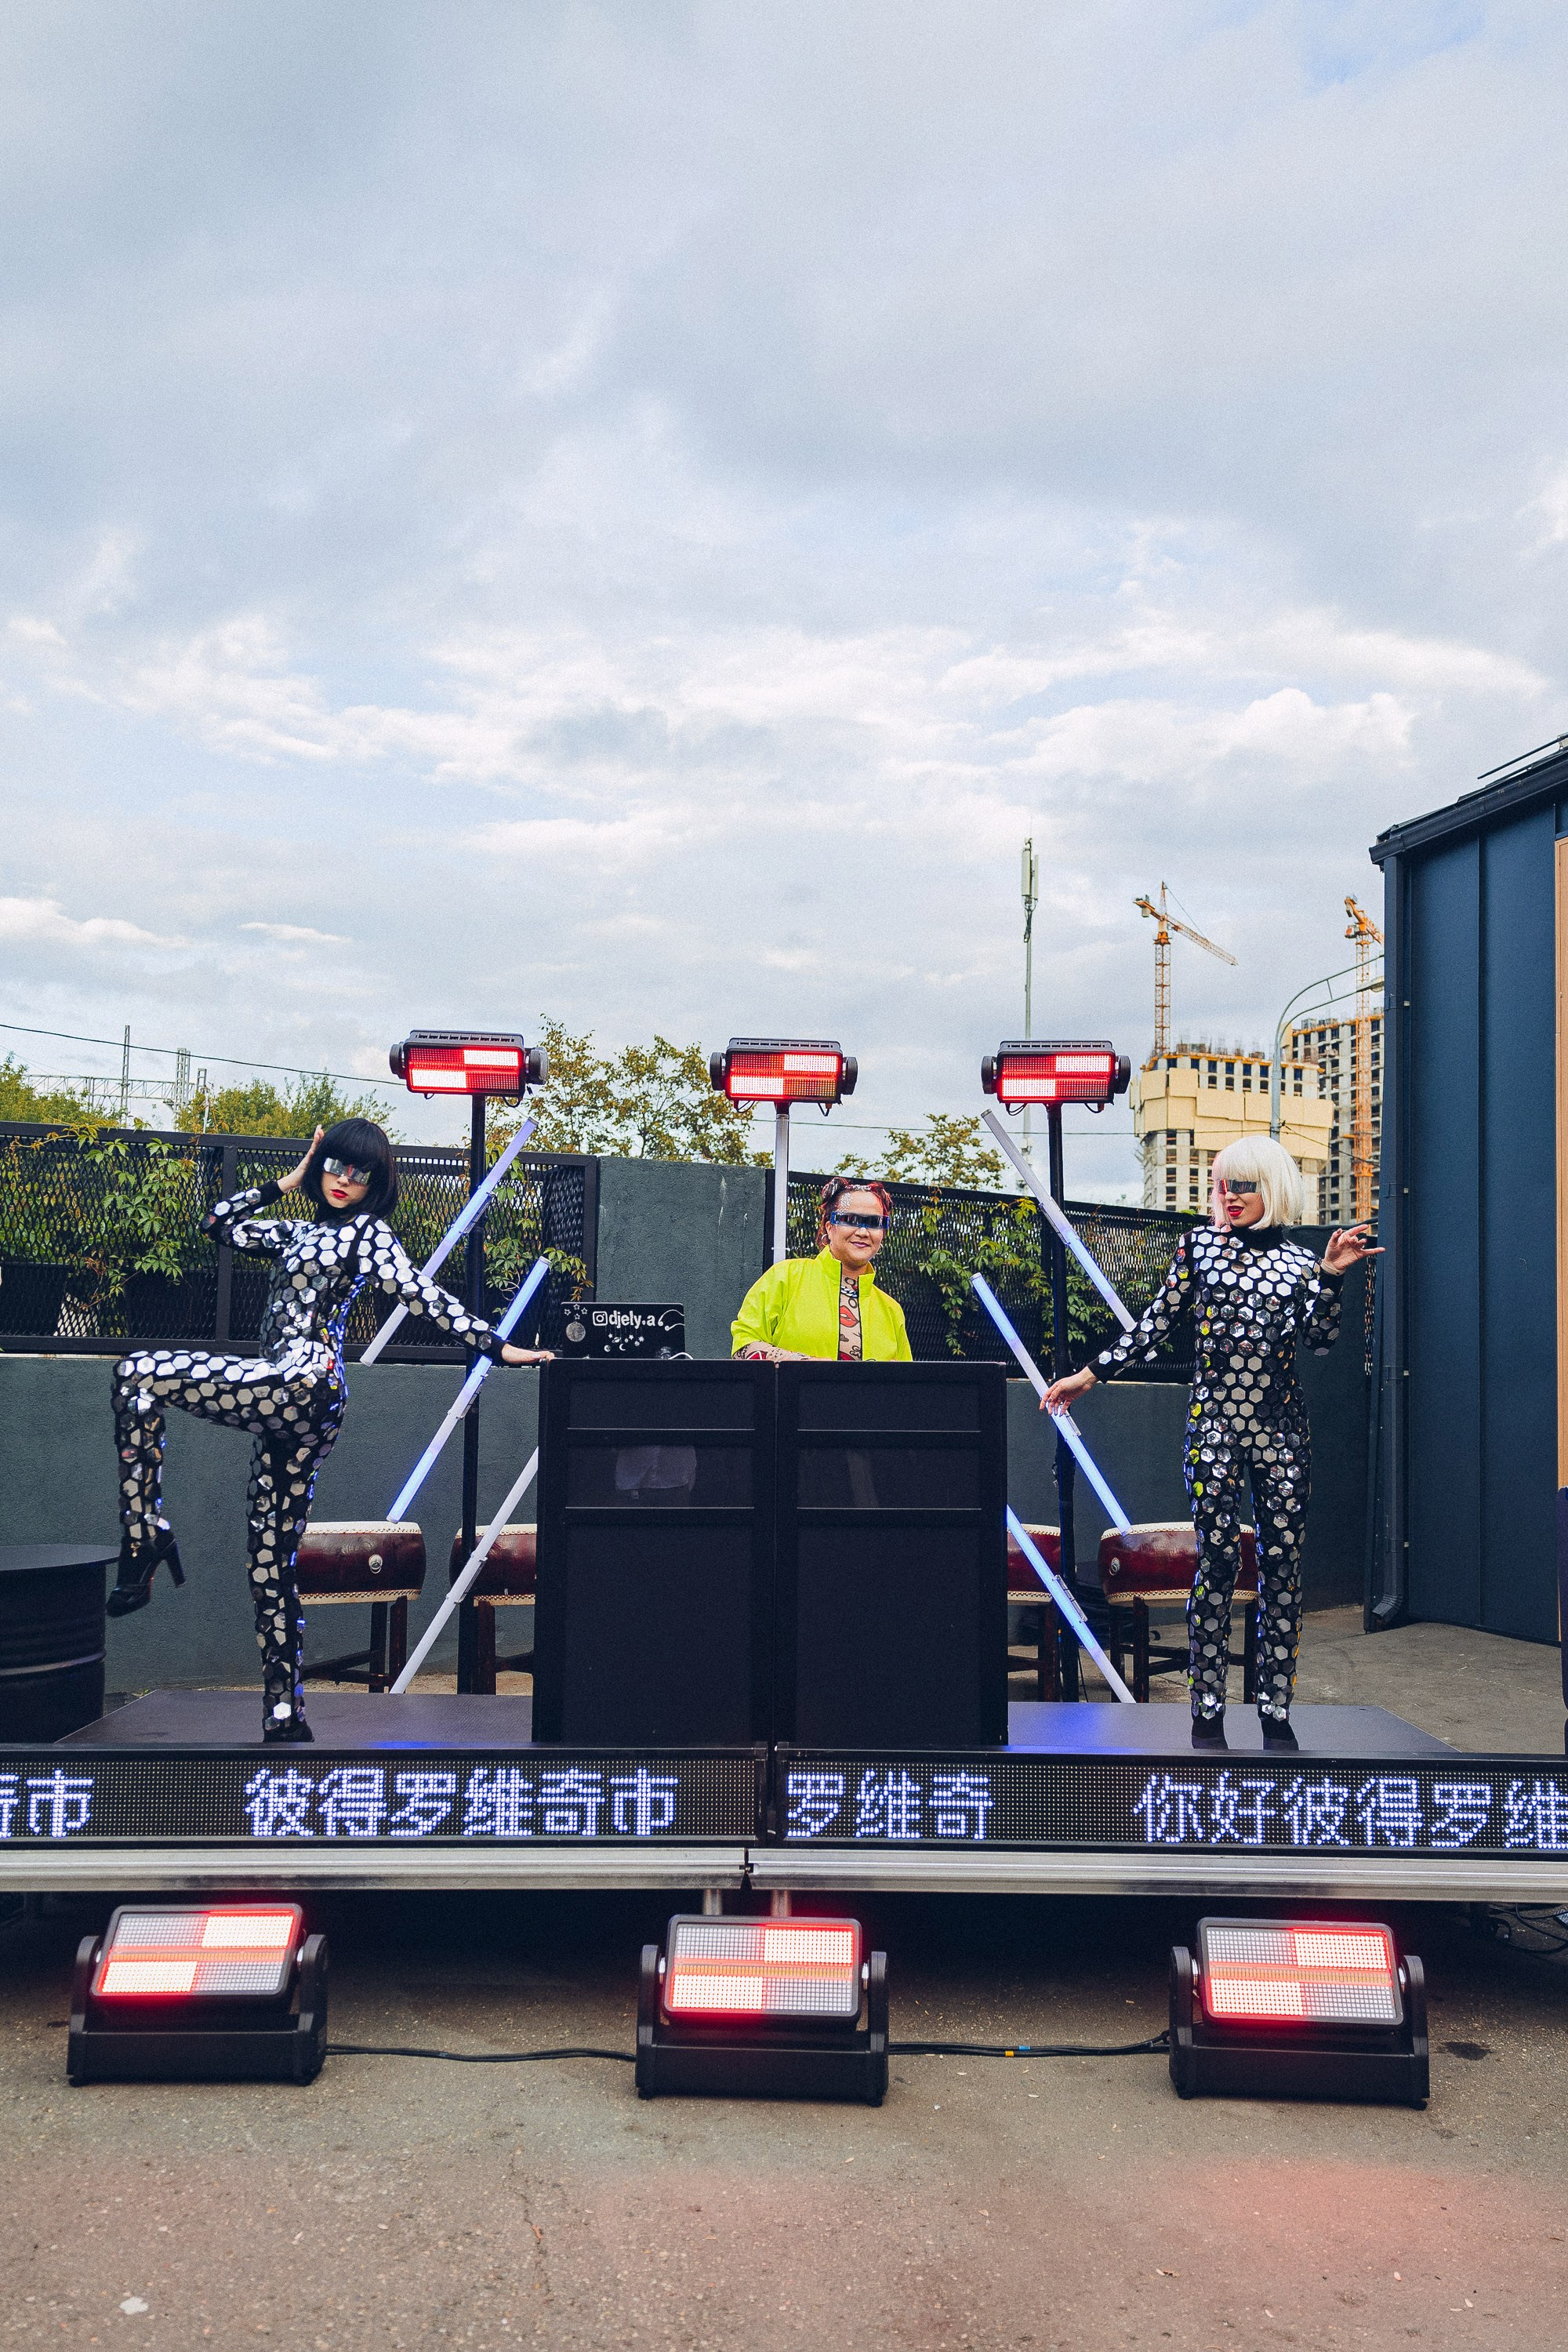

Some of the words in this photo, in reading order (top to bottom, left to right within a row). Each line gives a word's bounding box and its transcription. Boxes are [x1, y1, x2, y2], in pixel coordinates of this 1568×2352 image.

[608, 1310, 655, 1329] djely.a
[0, 1769, 93, 1837] 市
[245, 1768, 679, 1837] 彼得罗维奇市
[786, 1769, 994, 1840] 罗维奇
[1134, 1771, 1568, 1849] 你好彼得罗维
